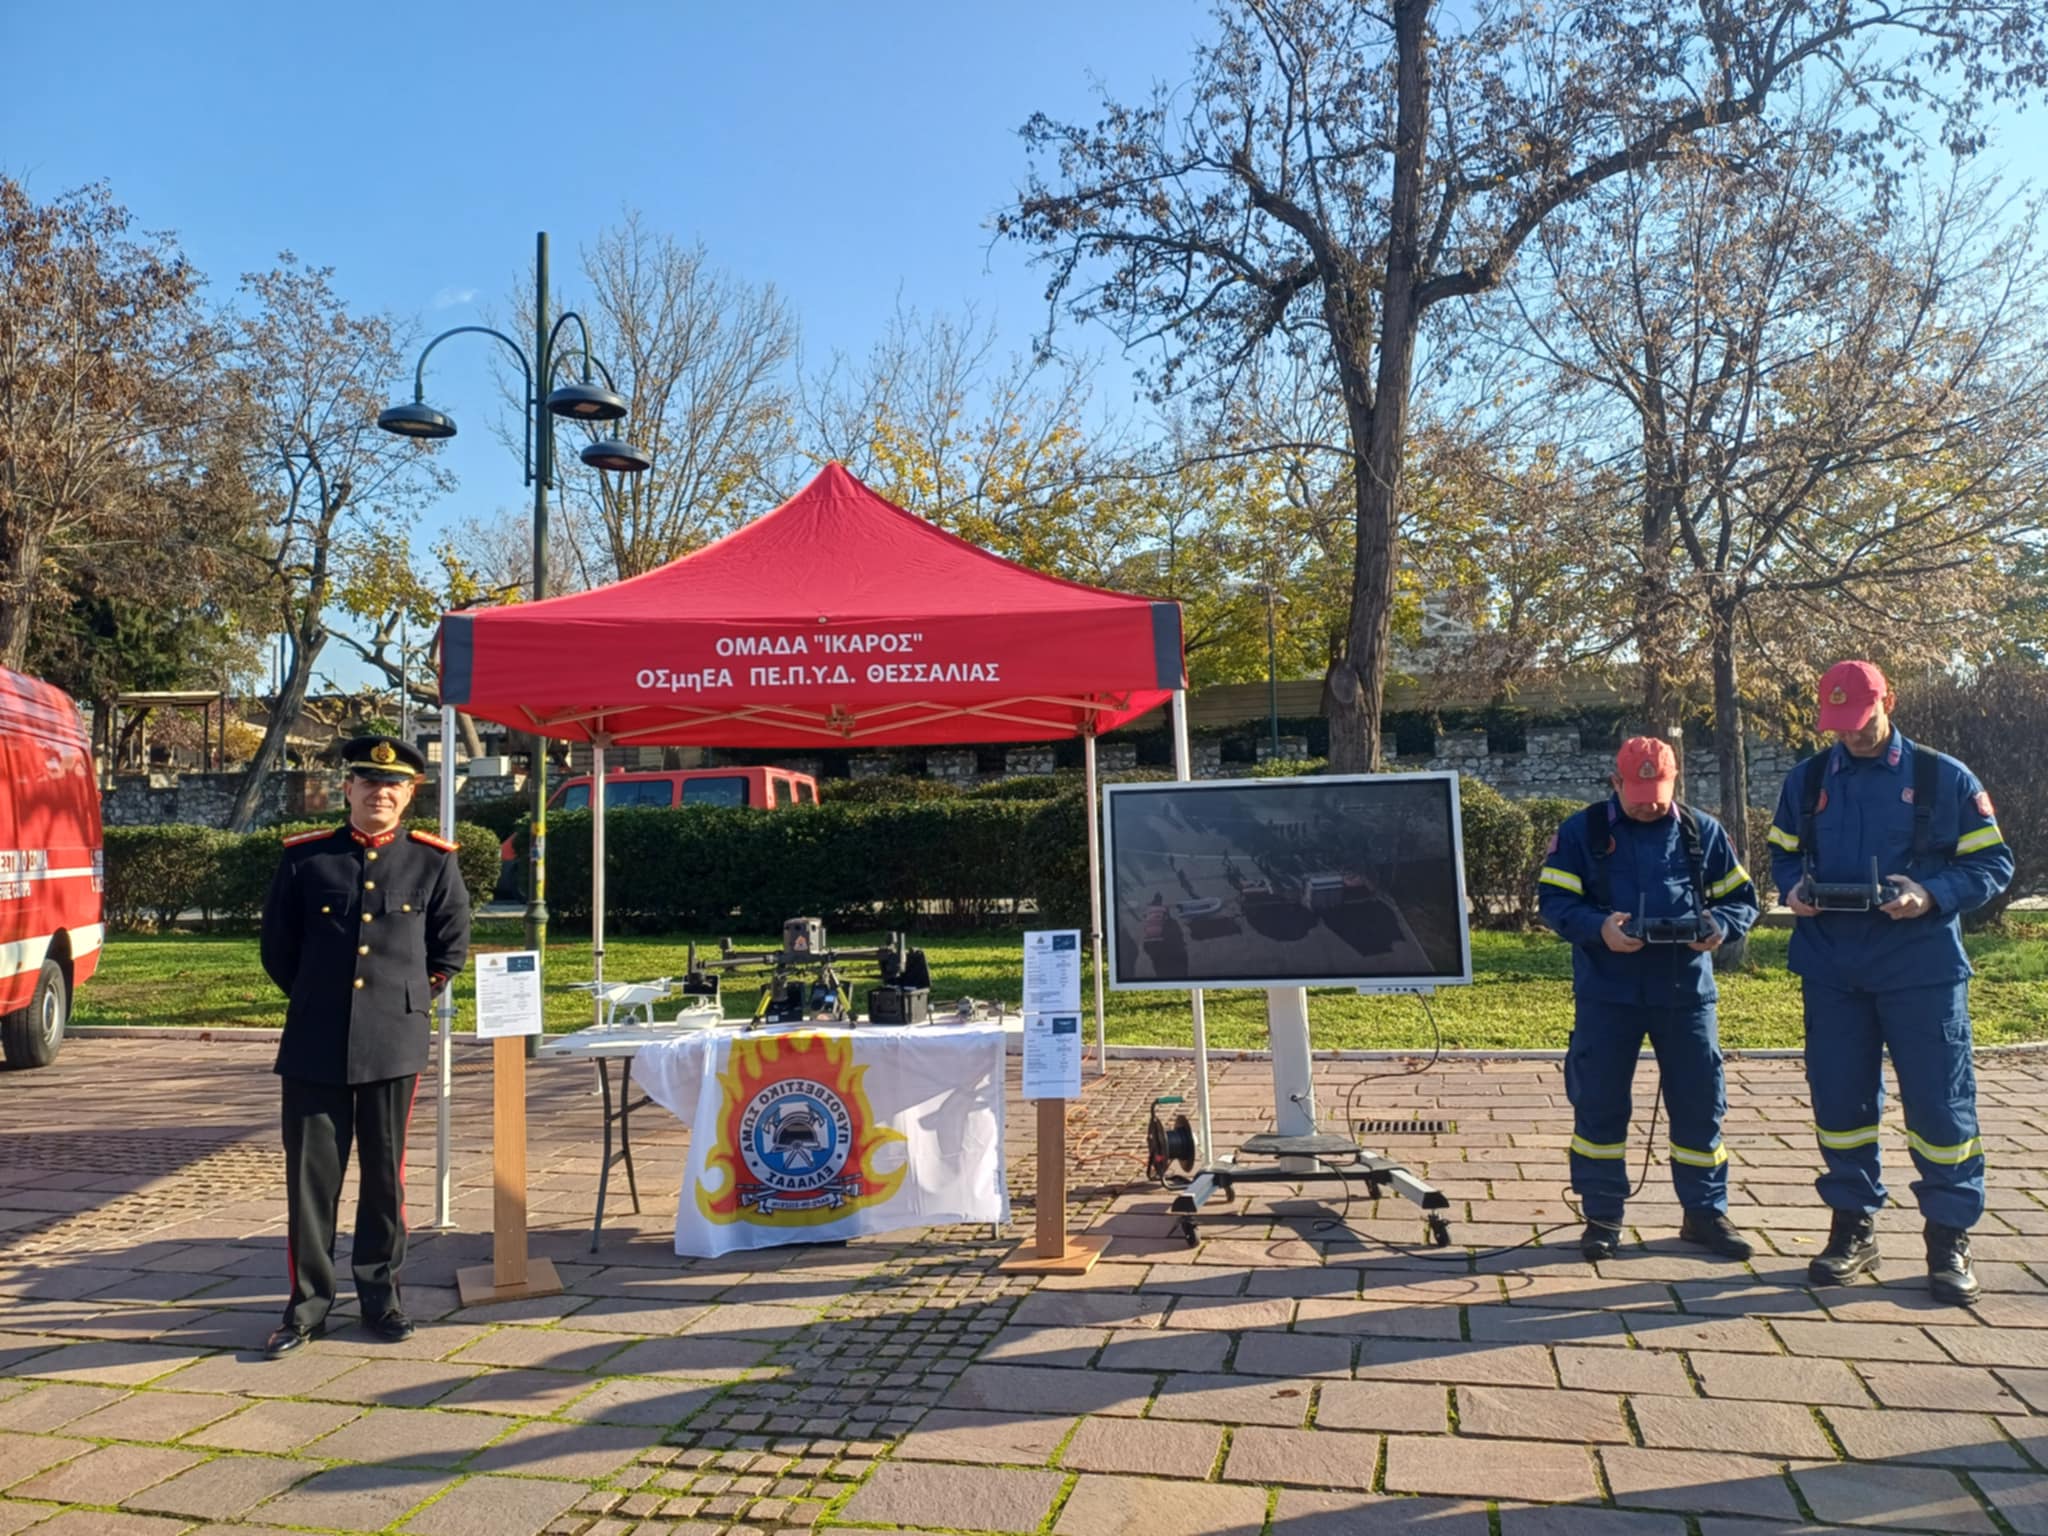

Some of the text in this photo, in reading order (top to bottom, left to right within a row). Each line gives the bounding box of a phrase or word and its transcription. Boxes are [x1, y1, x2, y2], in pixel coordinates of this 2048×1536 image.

[715, 632, 923, 657] ΟΜΑΔΑ "ΙΚΑΡΟΣ"
[636, 662, 1000, 692] ΟΣμηΕΑ ΠΕ.Π.Υ.Δ. ΘΕΣΣΑΛΙΑΣ
